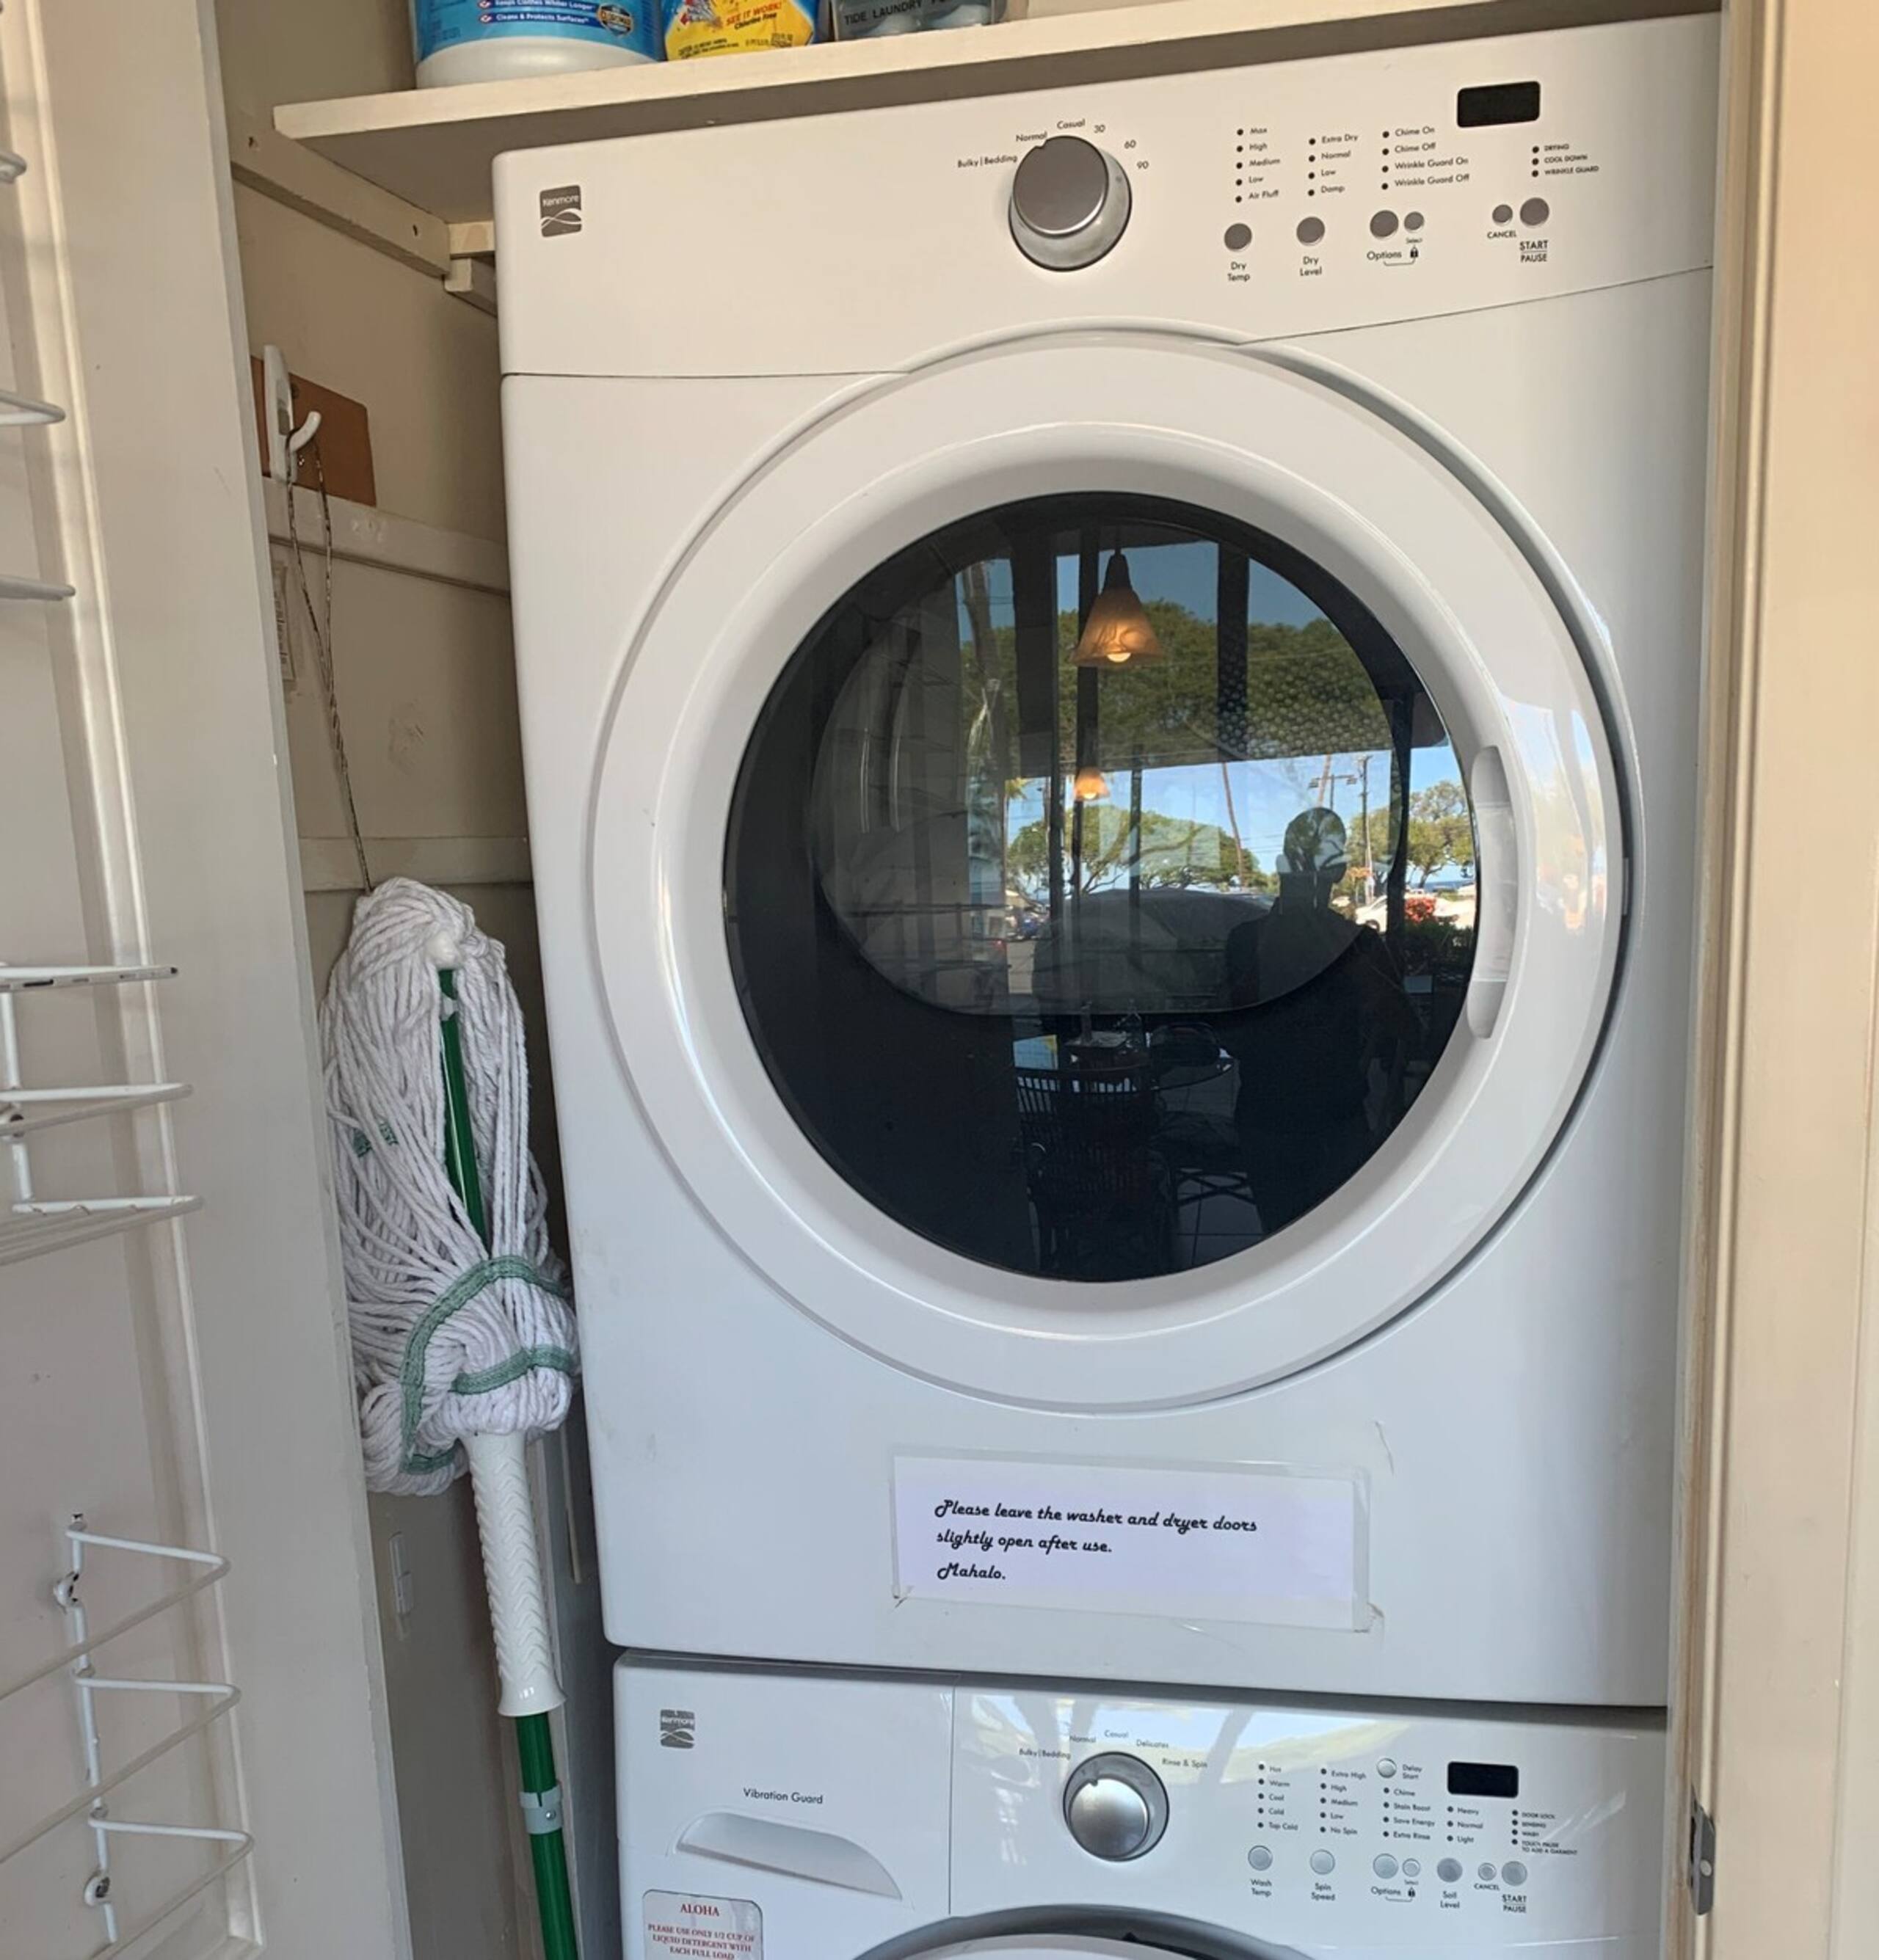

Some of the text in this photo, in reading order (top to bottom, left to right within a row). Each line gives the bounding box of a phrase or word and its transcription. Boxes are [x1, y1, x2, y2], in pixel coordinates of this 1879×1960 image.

[845, 0, 921, 26] TIDE LAUNDRY
[1057, 119, 1086, 129] Casual
[1094, 125, 1105, 134] 30
[1395, 126, 1435, 136] Chime On
[1016, 131, 1047, 142] Normal
[1322, 136, 1342, 144] Extra
[1124, 139, 1136, 149] 60
[1249, 142, 1267, 151] High
[1395, 142, 1436, 153] Chime Off
[1322, 150, 1351, 159] Normal
[1137, 161, 1149, 170] 90
[1249, 158, 1280, 167] Medium
[1395, 157, 1468, 170] Wrinkle Guard On
[1395, 173, 1470, 186] Wrinkle Guard Off
[1262, 189, 1279, 198] Fluff
[1487, 230, 1516, 238] CANCEL
[1519, 240, 1548, 250] START
[1303, 256, 1319, 266] Dry
[1367, 251, 1402, 261] Options
[1521, 254, 1547, 262] PAUSE
[1231, 261, 1246, 271] Dry
[1300, 266, 1322, 276] Level
[1227, 273, 1250, 282] Temp
[934, 1499, 1257, 1534] Please leave the washer and dryer doors
[937, 1529, 1112, 1555] slightly open after use.
[937, 1562, 1006, 1580] Mahalo.
[1104, 1730, 1128, 1738] Casual
[1069, 1735, 1096, 1744] Normal
[1136, 1739, 1169, 1749] Delicates
[1163, 1758, 1180, 1767] Rinse
[1192, 1760, 1207, 1768] Spin
[1403, 1764, 1422, 1773] Delay
[743, 1788, 823, 1804] Vibration Guard
[1412, 1818, 1435, 1827] Energy
[1251, 1887, 1271, 1897] Temp
[1315, 1882, 1331, 1892] Spin
[1371, 1887, 1401, 1895] Options
[1311, 1892, 1335, 1901] Speed
[1502, 1894, 1527, 1902] START
[680, 1903, 719, 1917] ALOHA
[1503, 1905, 1526, 1913] PAUSE
[648, 1923, 673, 1932] PLEASE
[691, 1929, 712, 1938] ONLY
[727, 1933, 743, 1941] CUP
[653, 1934, 752, 1952] LIQUID DETERGENT WITH
[670, 1946, 690, 1955] EACH
[692, 1949, 710, 1957] FULL
